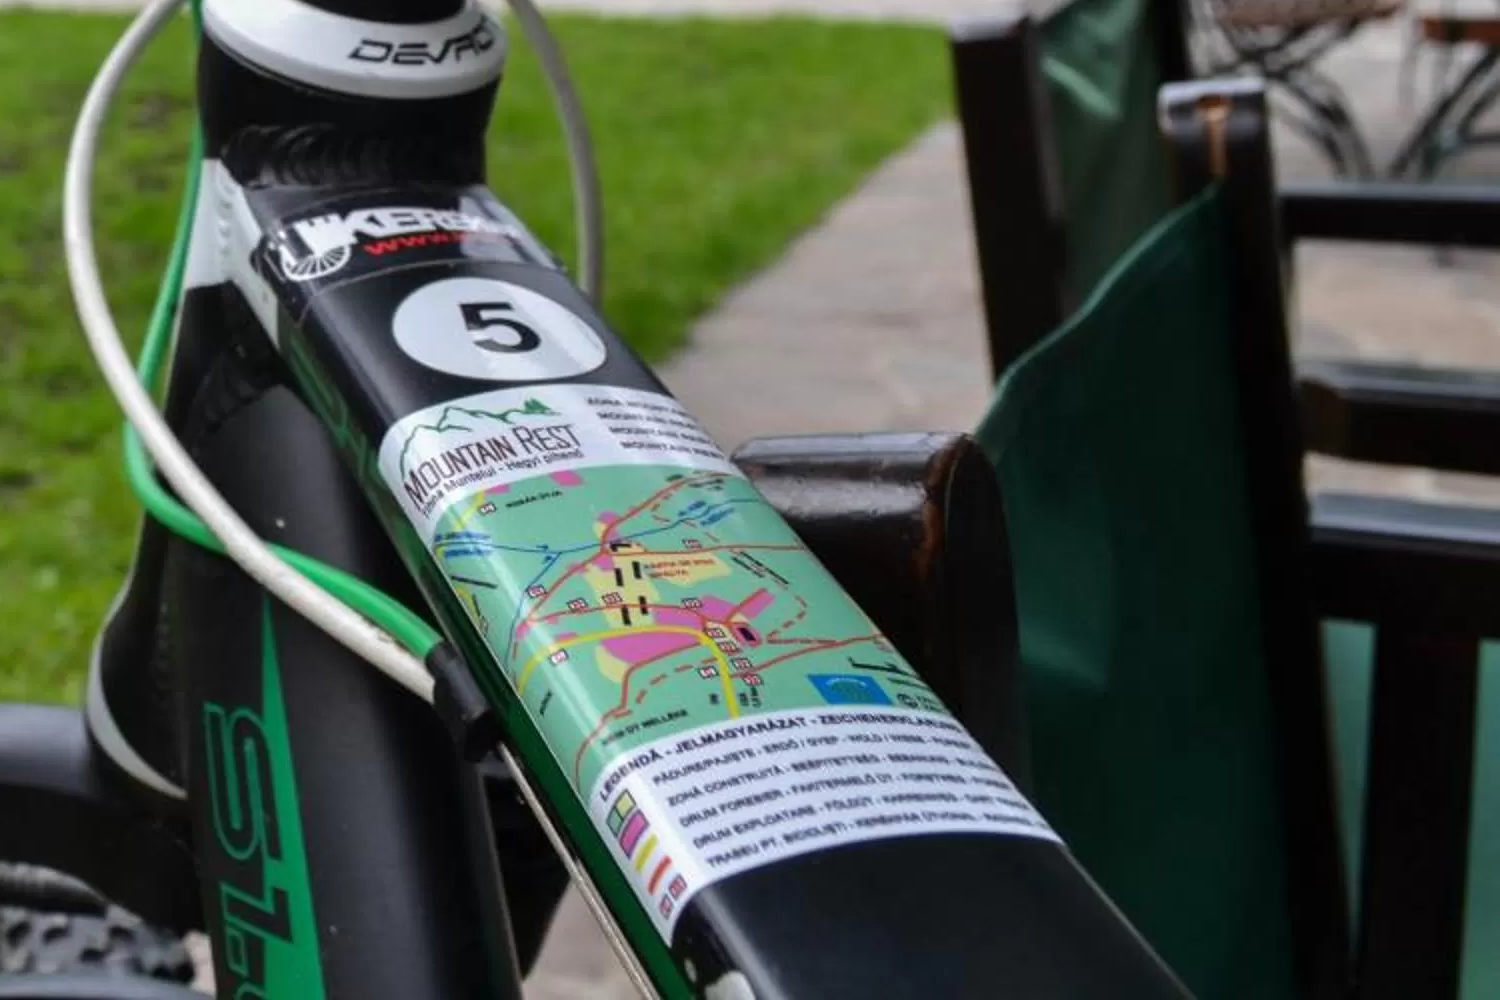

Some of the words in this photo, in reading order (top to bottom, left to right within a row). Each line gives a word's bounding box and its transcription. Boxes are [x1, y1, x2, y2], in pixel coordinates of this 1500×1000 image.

[458, 302, 542, 354] 5
[402, 435, 518, 512] MOUNTAIN
[511, 422, 582, 454] REST
